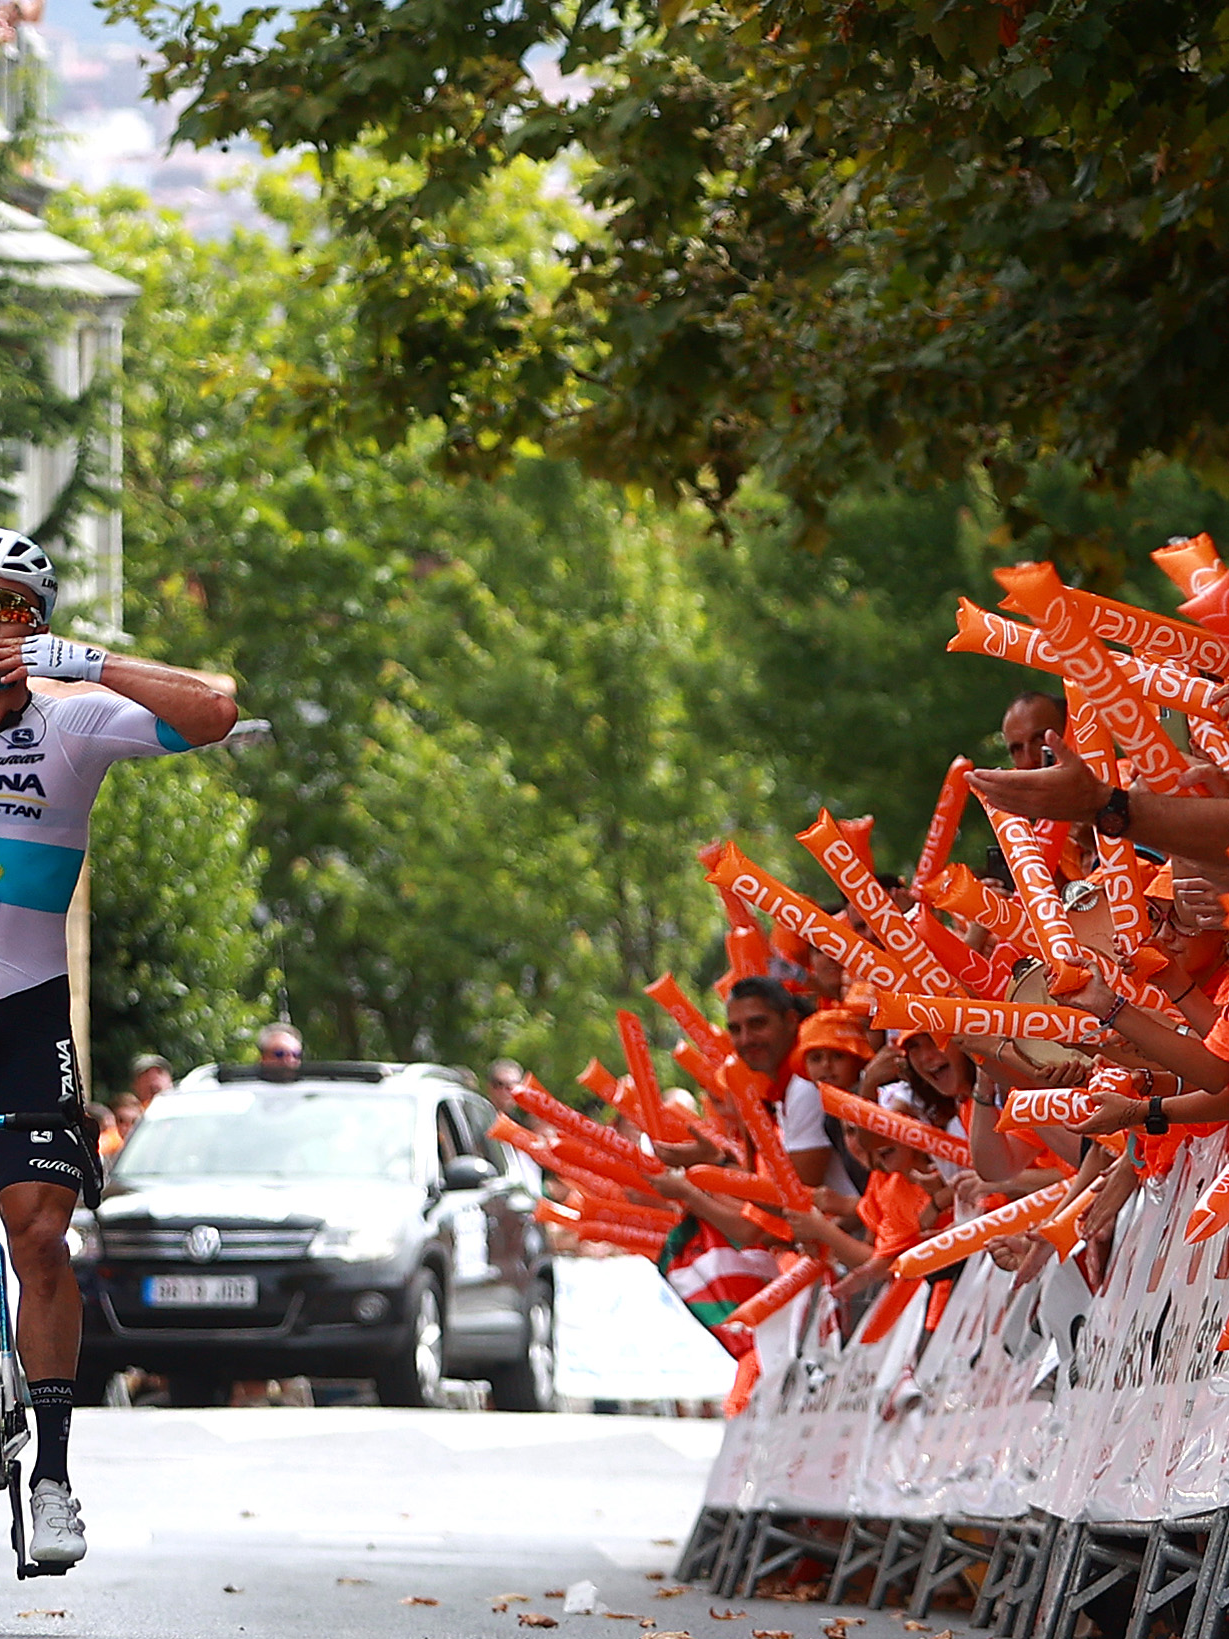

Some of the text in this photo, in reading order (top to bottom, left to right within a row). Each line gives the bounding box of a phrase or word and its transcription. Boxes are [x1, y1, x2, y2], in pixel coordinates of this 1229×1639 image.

[1090, 605, 1229, 675] skaltel
[1060, 636, 1188, 798] uskaltel
[731, 874, 908, 996] euskaltel
[823, 839, 956, 998] euskalte
[954, 1007, 1102, 1044] skaltel
[56, 1038, 74, 1097] TANA
[868, 1112, 969, 1166] uskaltel
[30, 1386, 73, 1395] STANA
